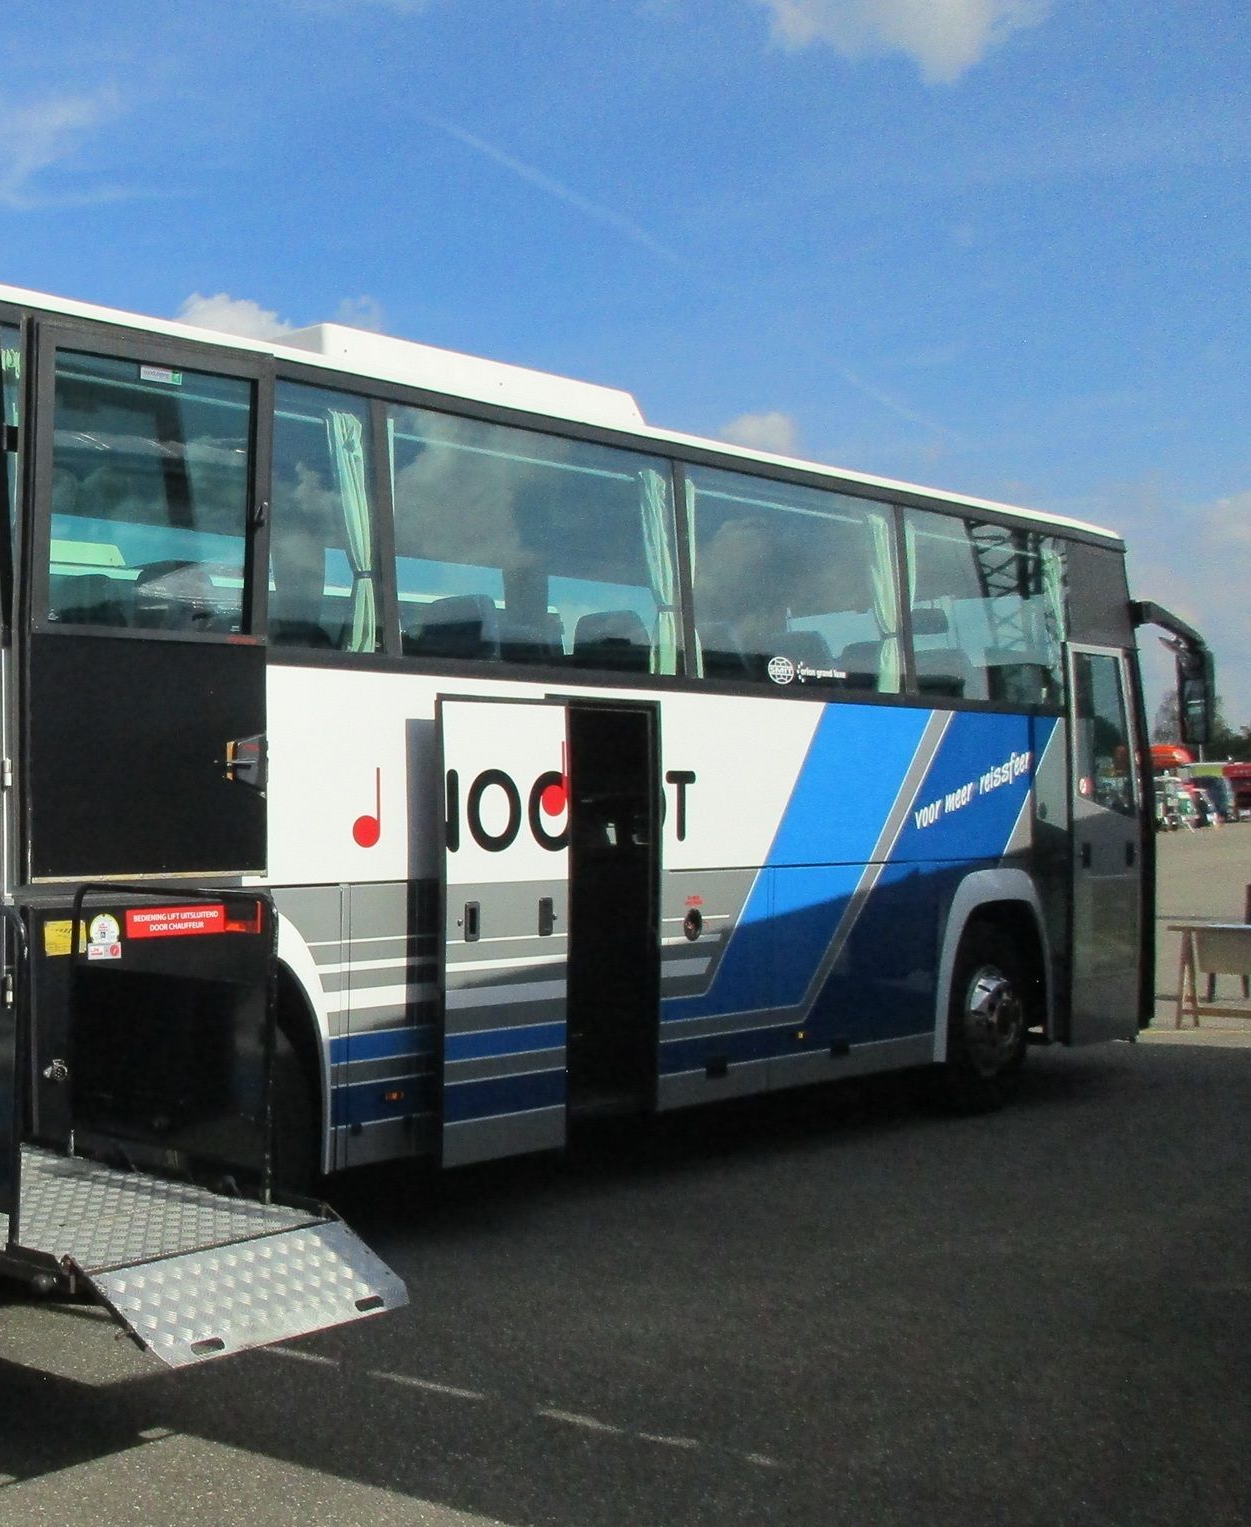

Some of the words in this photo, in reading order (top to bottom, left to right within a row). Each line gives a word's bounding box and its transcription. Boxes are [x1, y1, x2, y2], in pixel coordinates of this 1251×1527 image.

[914, 798, 942, 830] voor
[944, 782, 974, 814] meer
[979, 751, 1031, 795] reissfeer
[133, 913, 167, 922] BEDIENING
[167, 912, 180, 920] LIFT
[180, 911, 219, 920] UITSLUITEND
[149, 924, 168, 932] DOOR
[168, 921, 205, 931] CHAUFFEUR
